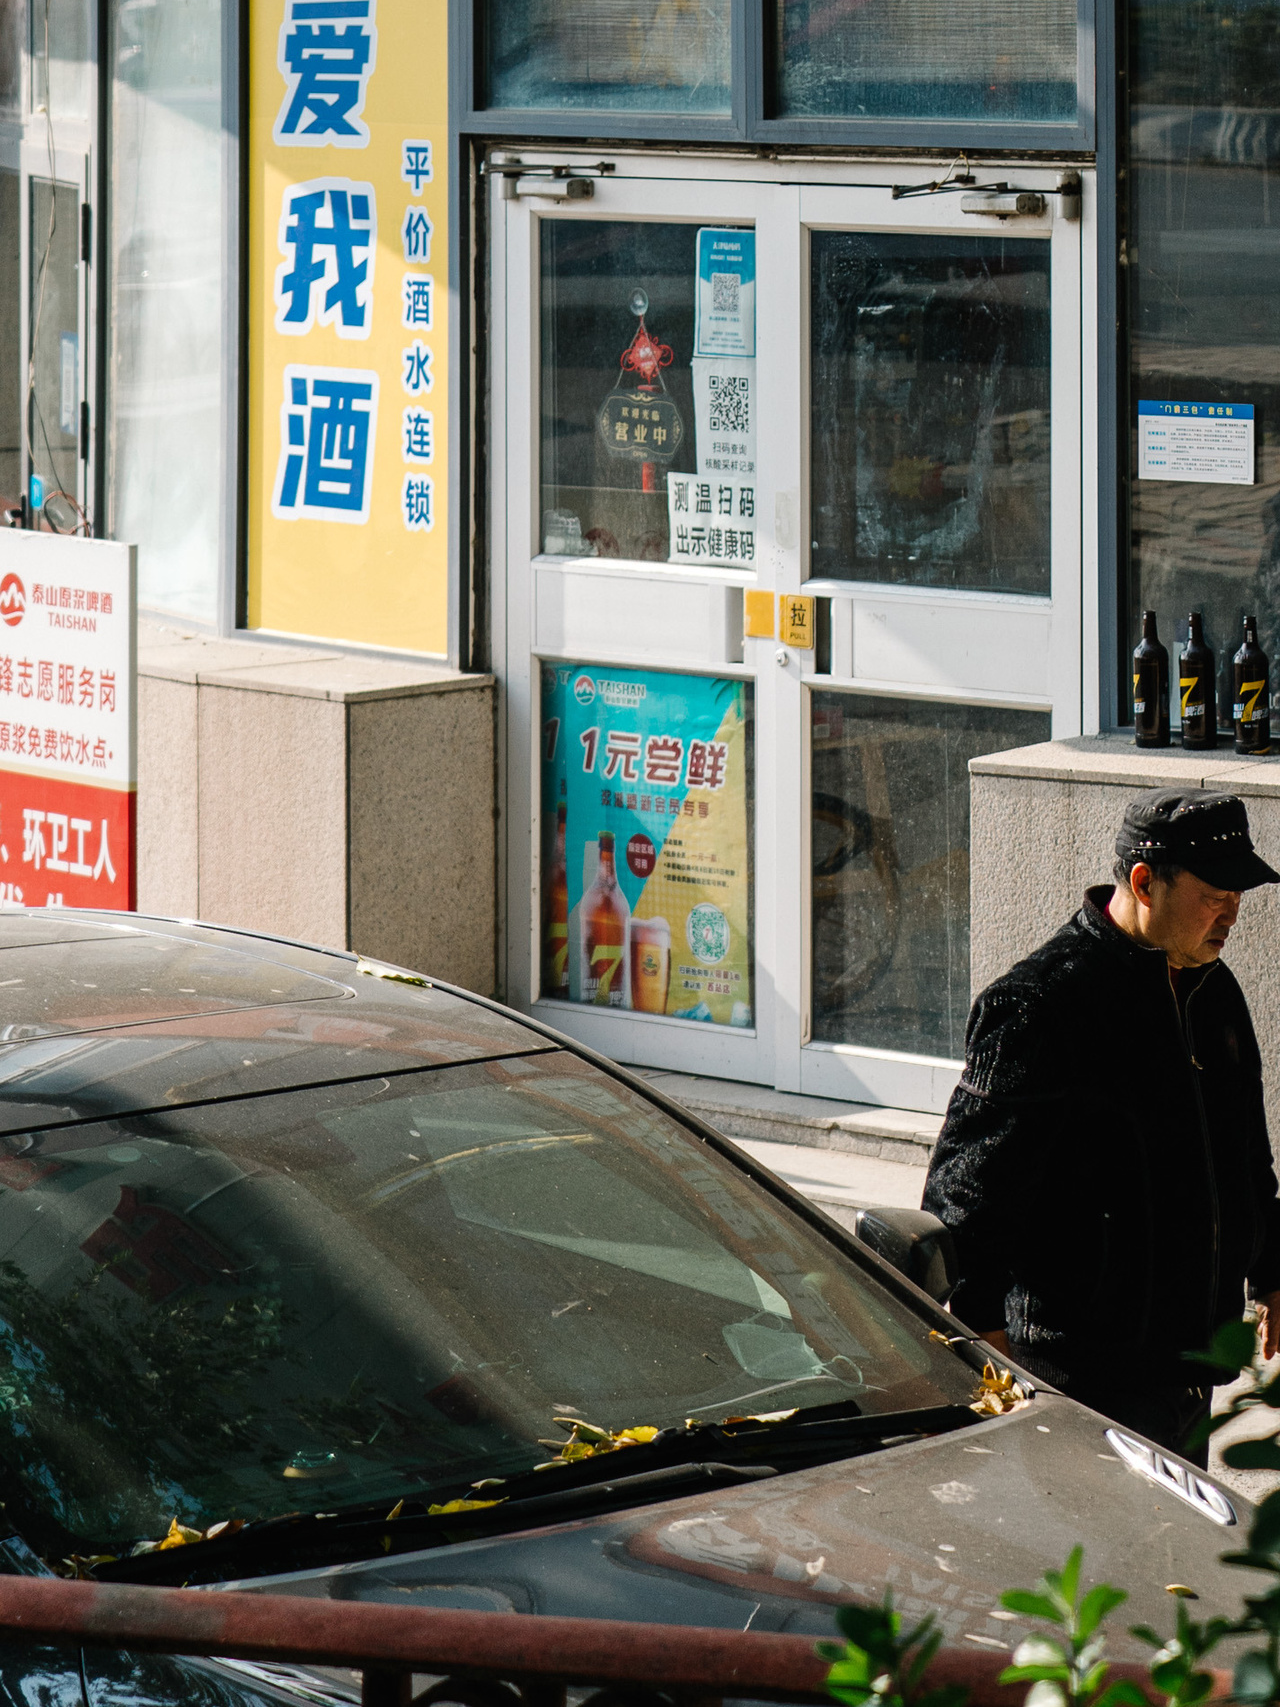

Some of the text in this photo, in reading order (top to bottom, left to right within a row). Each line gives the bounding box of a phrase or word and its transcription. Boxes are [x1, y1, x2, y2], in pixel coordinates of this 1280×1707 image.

[404, 145, 432, 527] 平价酒水连锁
[615, 421, 667, 445] 营业中
[712, 441, 747, 456] 扫码查询
[705, 458, 755, 473] 核酸采样记录
[674, 481, 754, 518] 测温扫码
[676, 524, 755, 560] 出示健康码
[32, 583, 113, 615] 泰山原浆啤酒
[48, 611, 97, 633] TAISHAN
[791, 602, 807, 627] 拉
[789, 631, 807, 641] PULL
[597, 679, 646, 697] TAISHAN
[581, 728, 728, 789] 1元尝鲜
